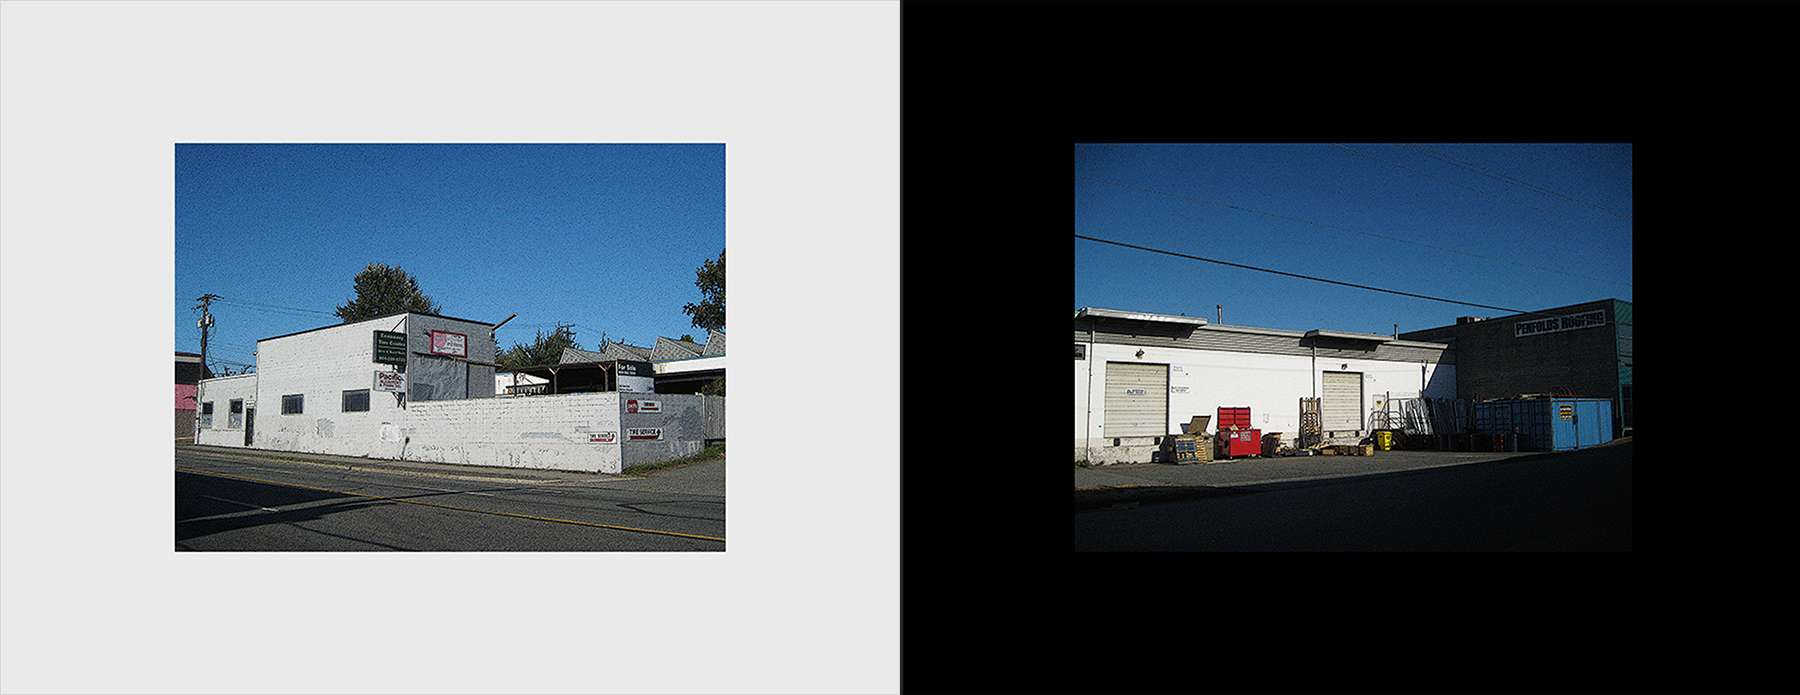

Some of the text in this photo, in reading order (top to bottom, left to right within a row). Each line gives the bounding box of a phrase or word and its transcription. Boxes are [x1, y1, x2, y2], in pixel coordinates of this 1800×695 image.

[1515, 311, 1604, 335] PENFOLDS ROOFING
[379, 372, 402, 381] Pacific
